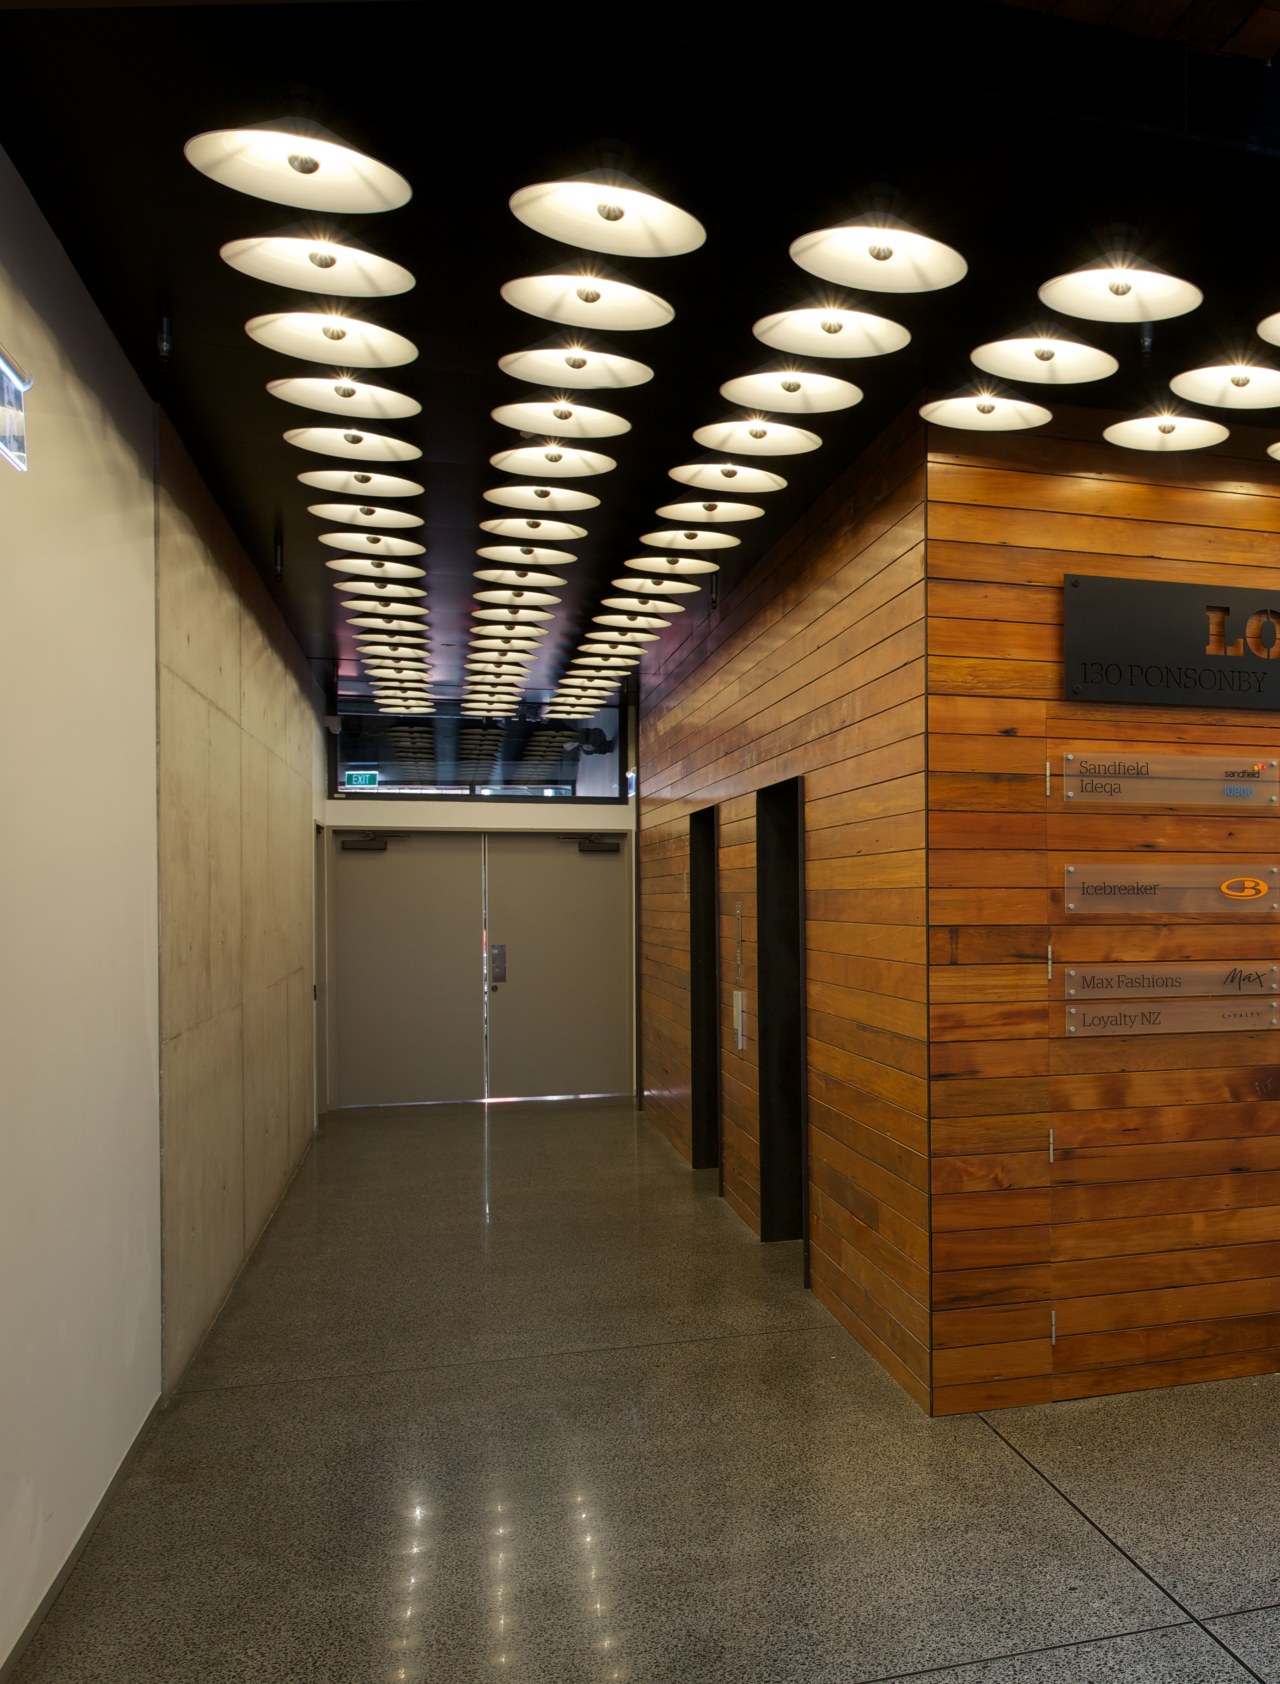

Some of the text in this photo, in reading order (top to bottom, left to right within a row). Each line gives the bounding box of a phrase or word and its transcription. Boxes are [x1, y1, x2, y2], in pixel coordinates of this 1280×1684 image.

[1080, 662, 1268, 693] 130 PONSONBY
[1079, 760, 1149, 776] Sandfield
[352, 774, 370, 785] EXIT
[1080, 779, 1122, 796] Ideqa
[1081, 881, 1159, 896] Icebreaker
[1081, 974, 1182, 989] Max Fashions
[1223, 967, 1267, 992] Max
[1082, 1011, 1162, 1029] Loyalty NZ
